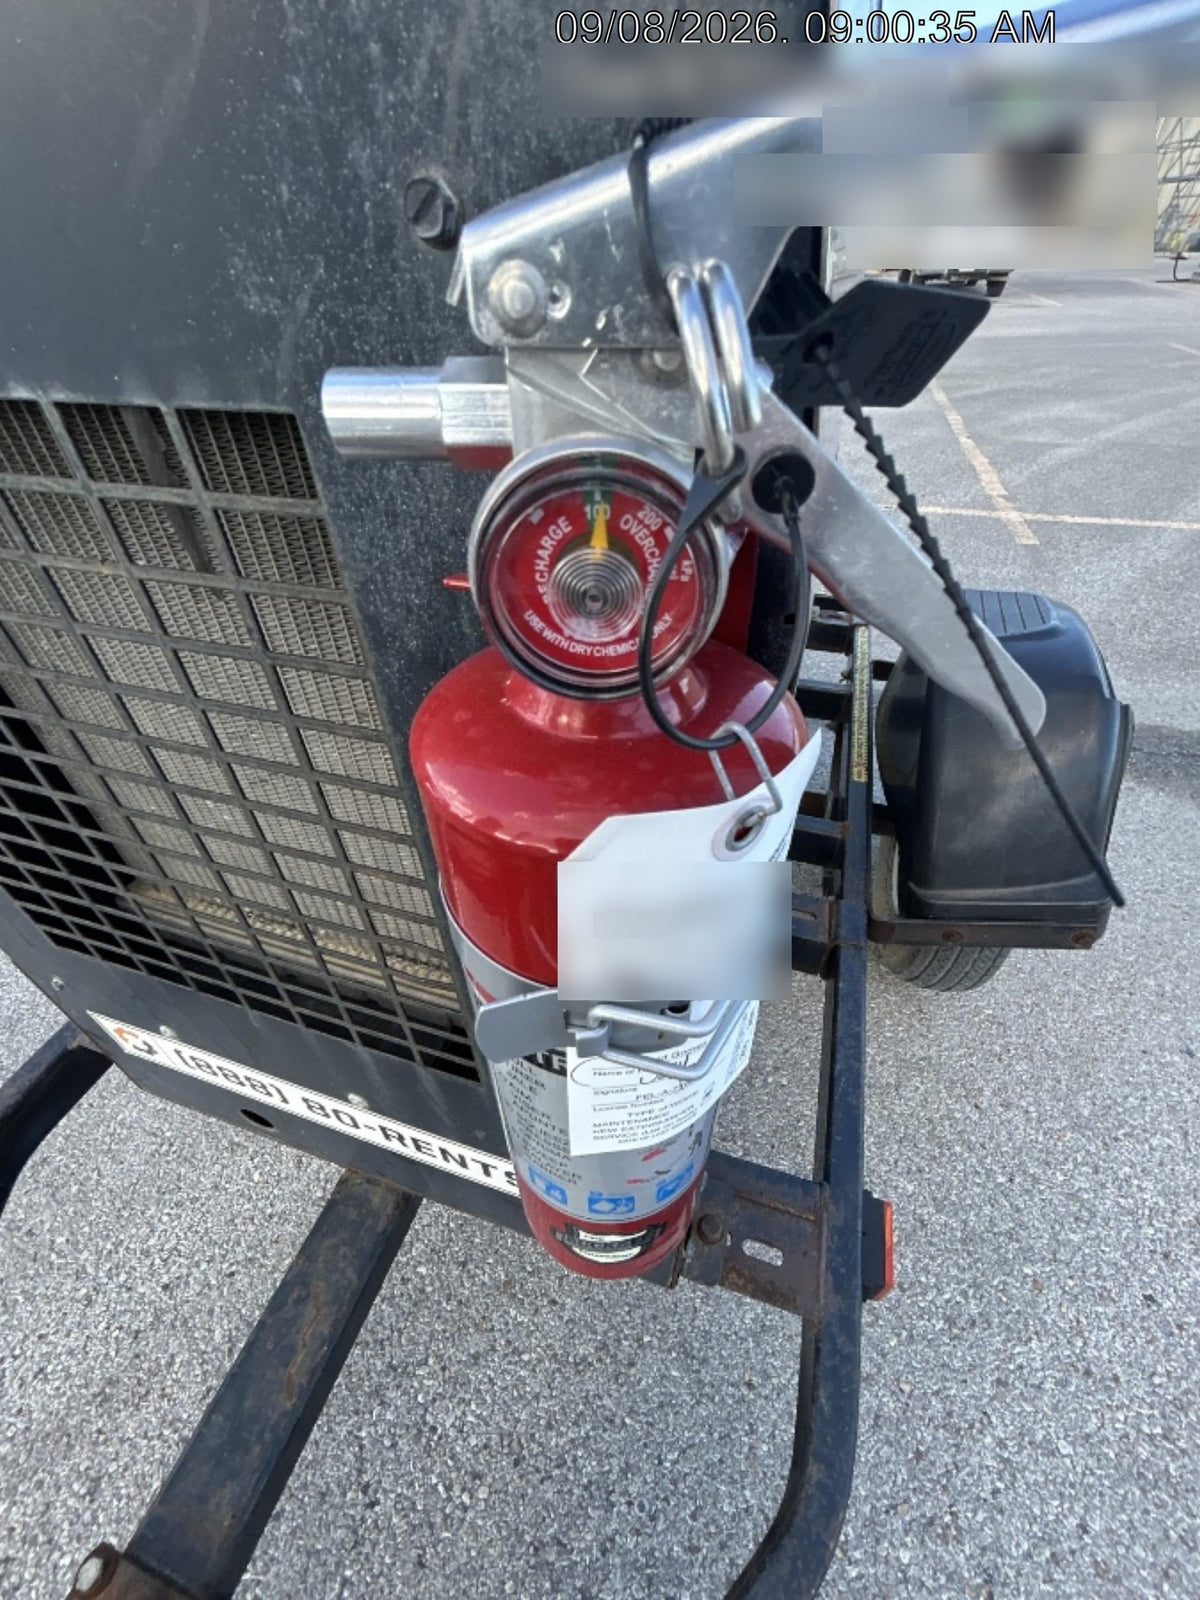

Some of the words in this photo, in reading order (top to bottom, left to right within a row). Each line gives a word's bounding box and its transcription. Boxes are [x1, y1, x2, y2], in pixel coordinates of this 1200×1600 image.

[636, 503, 662, 531] 200
[524, 609, 545, 633] USE
[542, 627, 570, 650] WITH
[568, 641, 594, 656] DRY
[593, 638, 640, 657] CHEMIC
[173, 1048, 290, 1105] (888)
